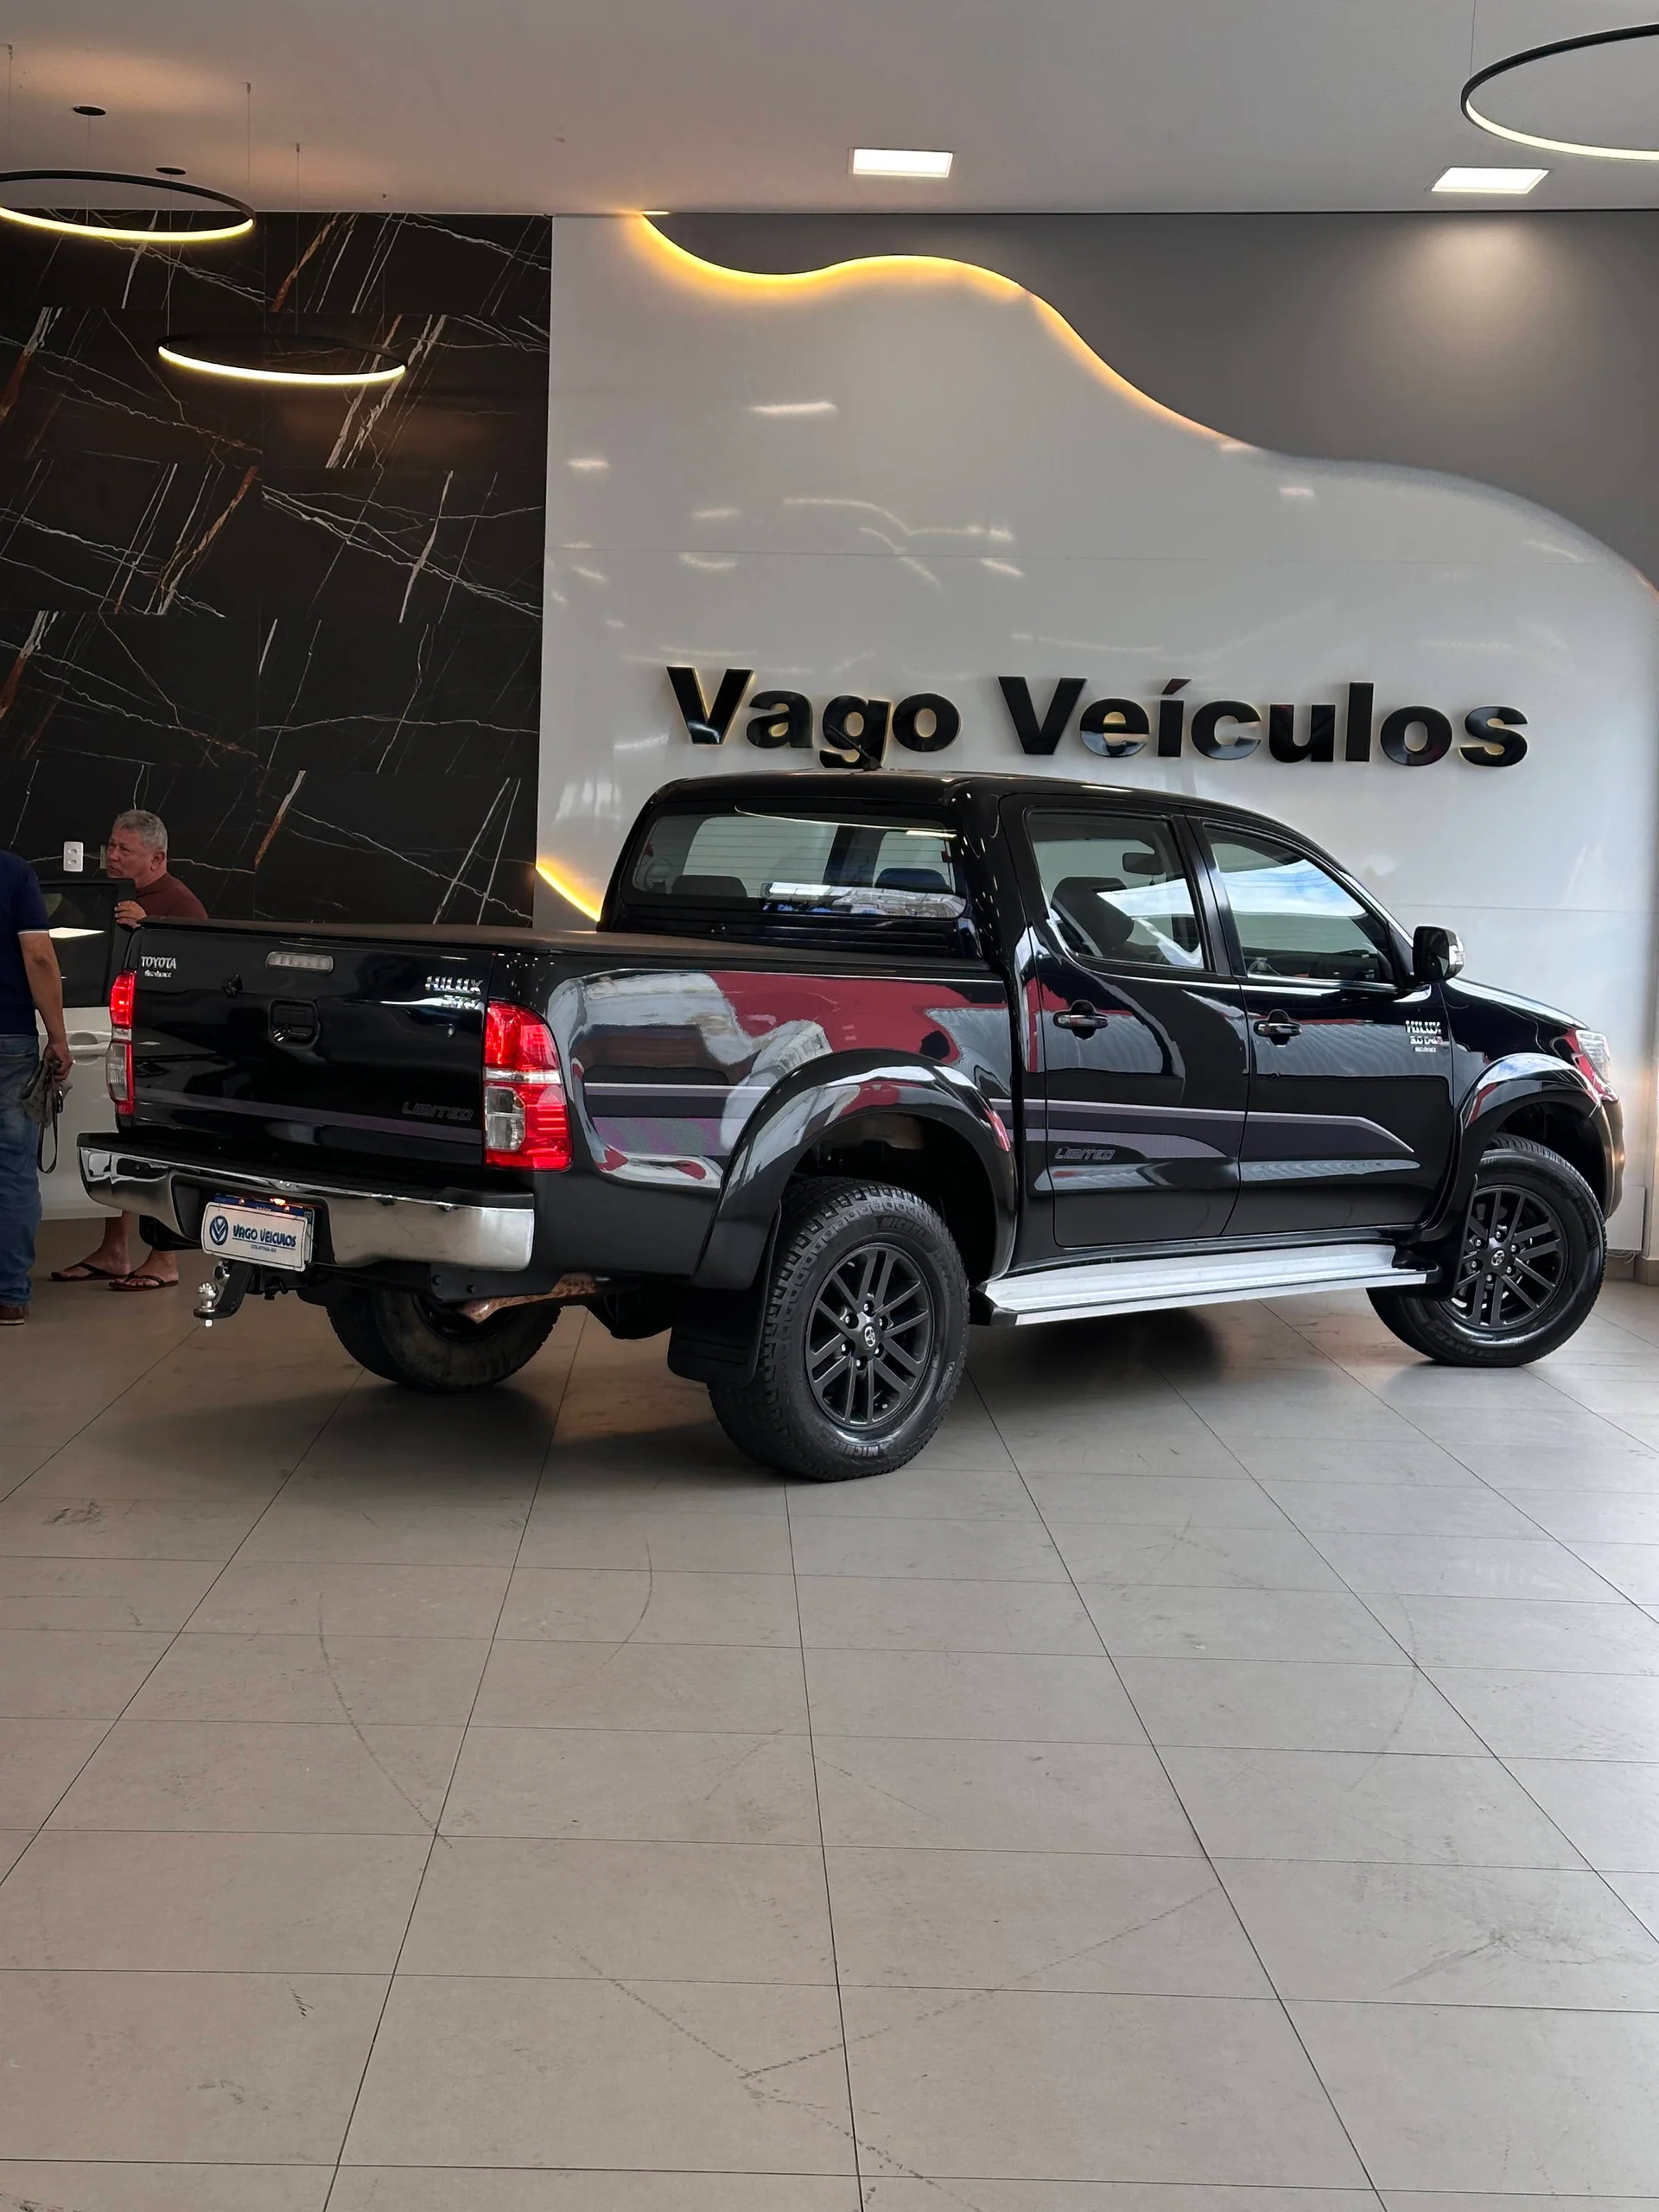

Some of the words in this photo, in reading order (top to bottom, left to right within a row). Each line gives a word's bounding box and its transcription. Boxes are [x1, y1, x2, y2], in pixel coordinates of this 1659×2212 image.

[665, 665, 960, 769] Vago
[997, 675, 1528, 767] Veículos
[141, 956, 177, 969] TOYOTA
[425, 976, 484, 995] HILUX
[402, 1101, 474, 1121] LIMITED
[1054, 1147, 1116, 1160] LIMITED
[232, 1224, 257, 1240] VAGO
[260, 1228, 296, 1247] VEICULOS
